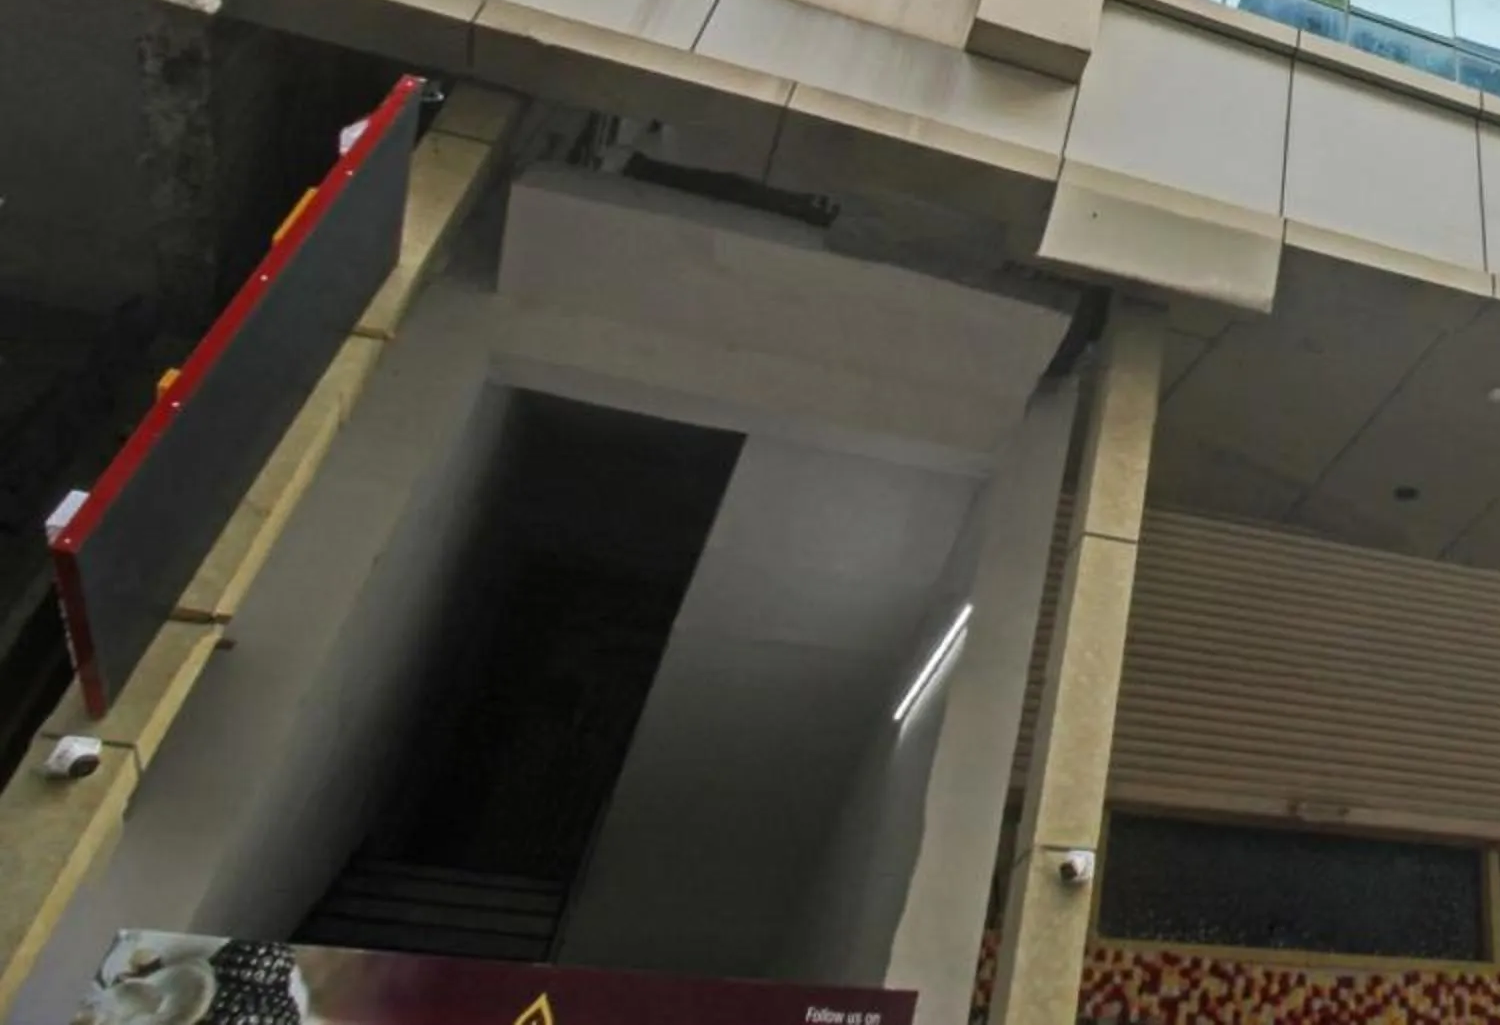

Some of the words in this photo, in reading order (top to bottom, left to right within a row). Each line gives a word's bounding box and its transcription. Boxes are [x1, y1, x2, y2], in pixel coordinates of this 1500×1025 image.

[805, 1006, 844, 1024] Follow
[846, 1012, 862, 1025] us
[864, 1012, 882, 1025] on
